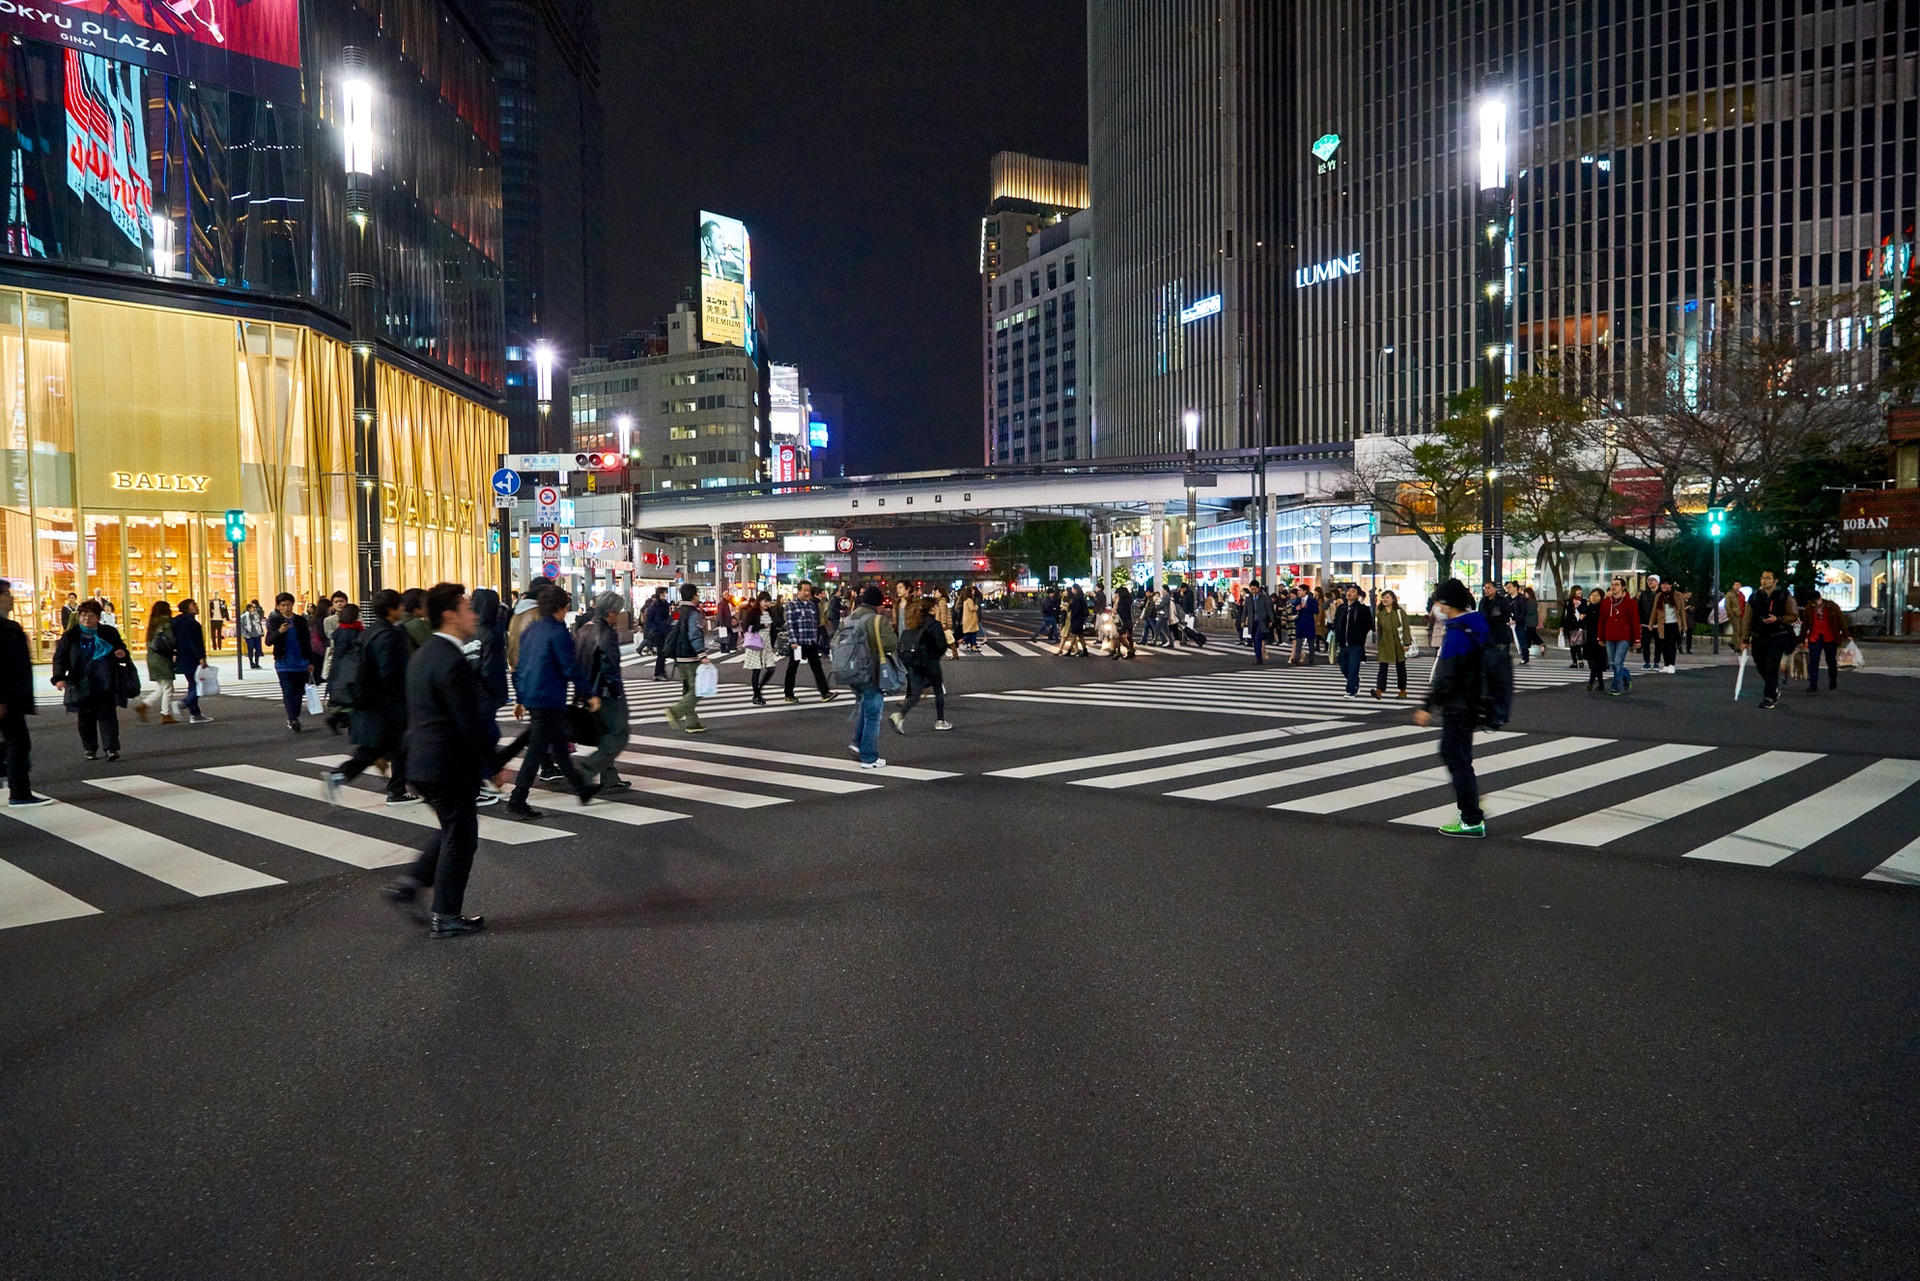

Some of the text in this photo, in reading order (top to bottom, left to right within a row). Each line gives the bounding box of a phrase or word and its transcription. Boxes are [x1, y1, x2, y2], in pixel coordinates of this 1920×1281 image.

[60, 33, 97, 48] GINZA
[81, 22, 168, 56] PLAZA
[1296, 252, 1361, 289] LUMINE
[706, 315, 741, 328] PREMIUM
[114, 472, 209, 492] BALLY
[382, 481, 475, 534] BALLY
[1843, 517, 1889, 530] KOBAN
